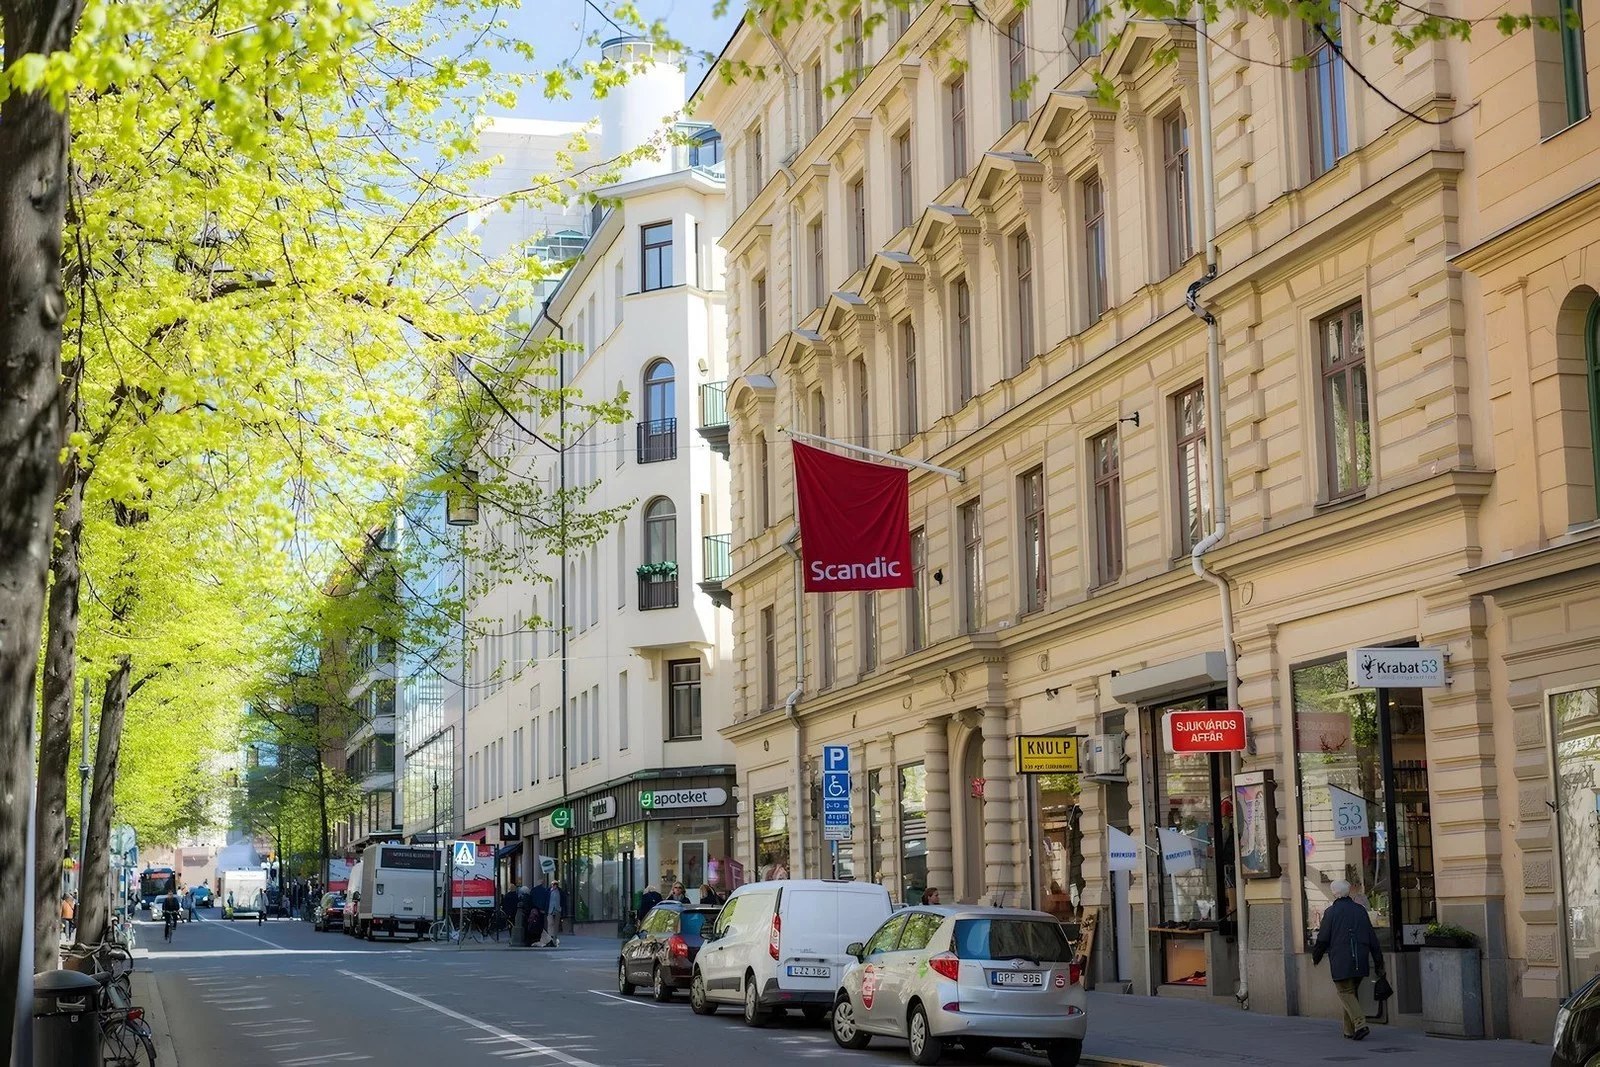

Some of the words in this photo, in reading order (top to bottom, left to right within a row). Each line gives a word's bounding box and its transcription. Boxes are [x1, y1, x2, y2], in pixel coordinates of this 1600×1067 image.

[811, 556, 901, 581] Scandic
[1376, 661, 1419, 674] Krabat
[1421, 659, 1438, 673] 53
[1027, 741, 1071, 755] KNULP
[829, 748, 845, 770] P
[654, 791, 708, 806] apoteket
[1338, 805, 1363, 826] 53
[503, 822, 517, 836] N
[1022, 974, 1041, 983] 986
